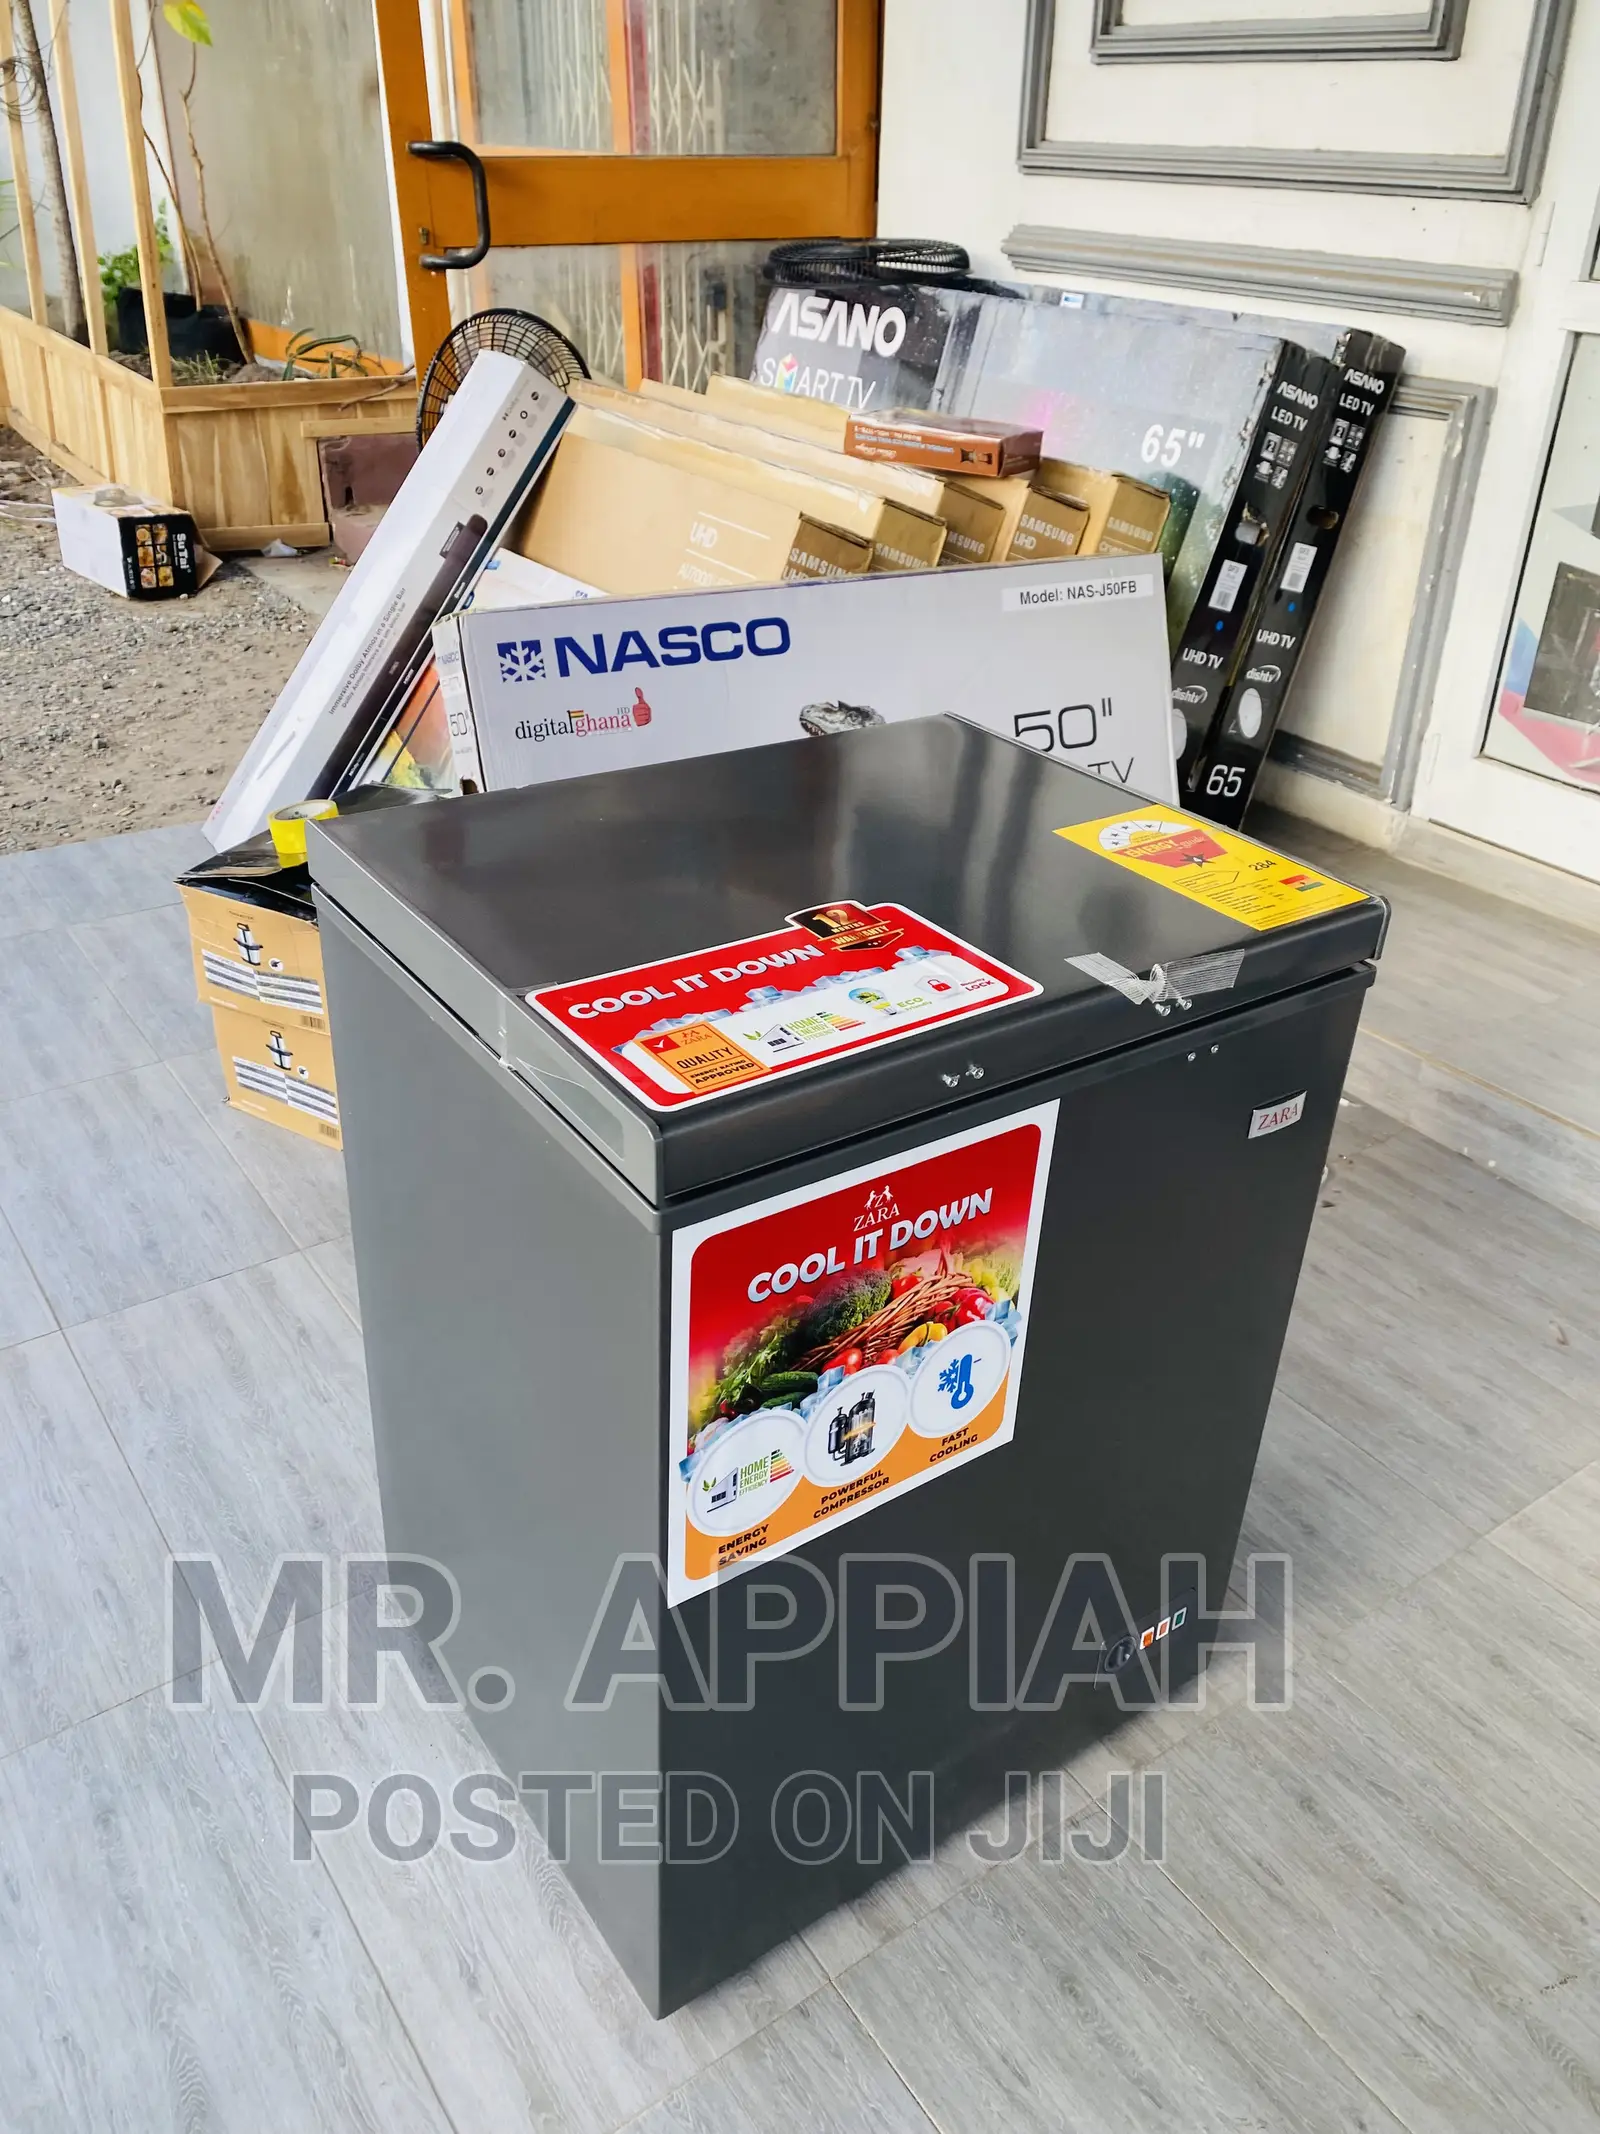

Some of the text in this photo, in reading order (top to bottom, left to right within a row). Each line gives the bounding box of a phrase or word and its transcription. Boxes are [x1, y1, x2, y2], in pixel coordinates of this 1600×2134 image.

[771, 292, 907, 358] ASANO
[760, 353, 877, 409] SMART TV
[1344, 368, 1385, 395] ASANO
[1276, 381, 1319, 411] ASANO
[1339, 392, 1376, 417] LED TV
[1270, 405, 1309, 432] LED TV
[1141, 423, 1206, 468] 65"
[690, 521, 718, 548] UHD
[948, 530, 986, 555] MSUNG
[1014, 531, 1037, 550] UHD
[1020, 514, 1075, 546] SAMSUNG
[789, 547, 853, 578] SAMSUN
[1019, 580, 1138, 606] Model: NAS-J50FB
[554, 617, 791, 678] NASCO
[1256, 629, 1296, 650] UHD TV
[1182, 647, 1224, 669] UHD TV
[329, 679, 352, 715] Immersive
[349, 657, 365, 680] Dolby
[362, 635, 379, 658] Atmos
[1013, 697, 1113, 753] 50"
[1206, 764, 1246, 797] 65
[1124, 839, 1178, 858] ENERGY
[812, 909, 849, 929] 12
[567, 944, 826, 1020] COOL IT DOWN
[965, 980, 995, 992] LOCK
[897, 997, 925, 1008] ECO
[676, 1047, 734, 1069] QUALITY
[695, 1062, 755, 1084] APPROVED
[1257, 1103, 1298, 1130] ZARA
[853, 1202, 901, 1232] ZARA
[747, 1187, 994, 1304] COOL IT DOWN
[929, 1434, 979, 1463] COOLING
[941, 1427, 970, 1447] FAST
[739, 1455, 770, 1481] HOME
[739, 1469, 769, 1489] ENERGY
[813, 1476, 890, 1519] COMPRESSOR
[820, 1469, 885, 1505] POWERFUL
[718, 1523, 769, 1554] ENERGY
[718, 1537, 767, 1566] SAVING
